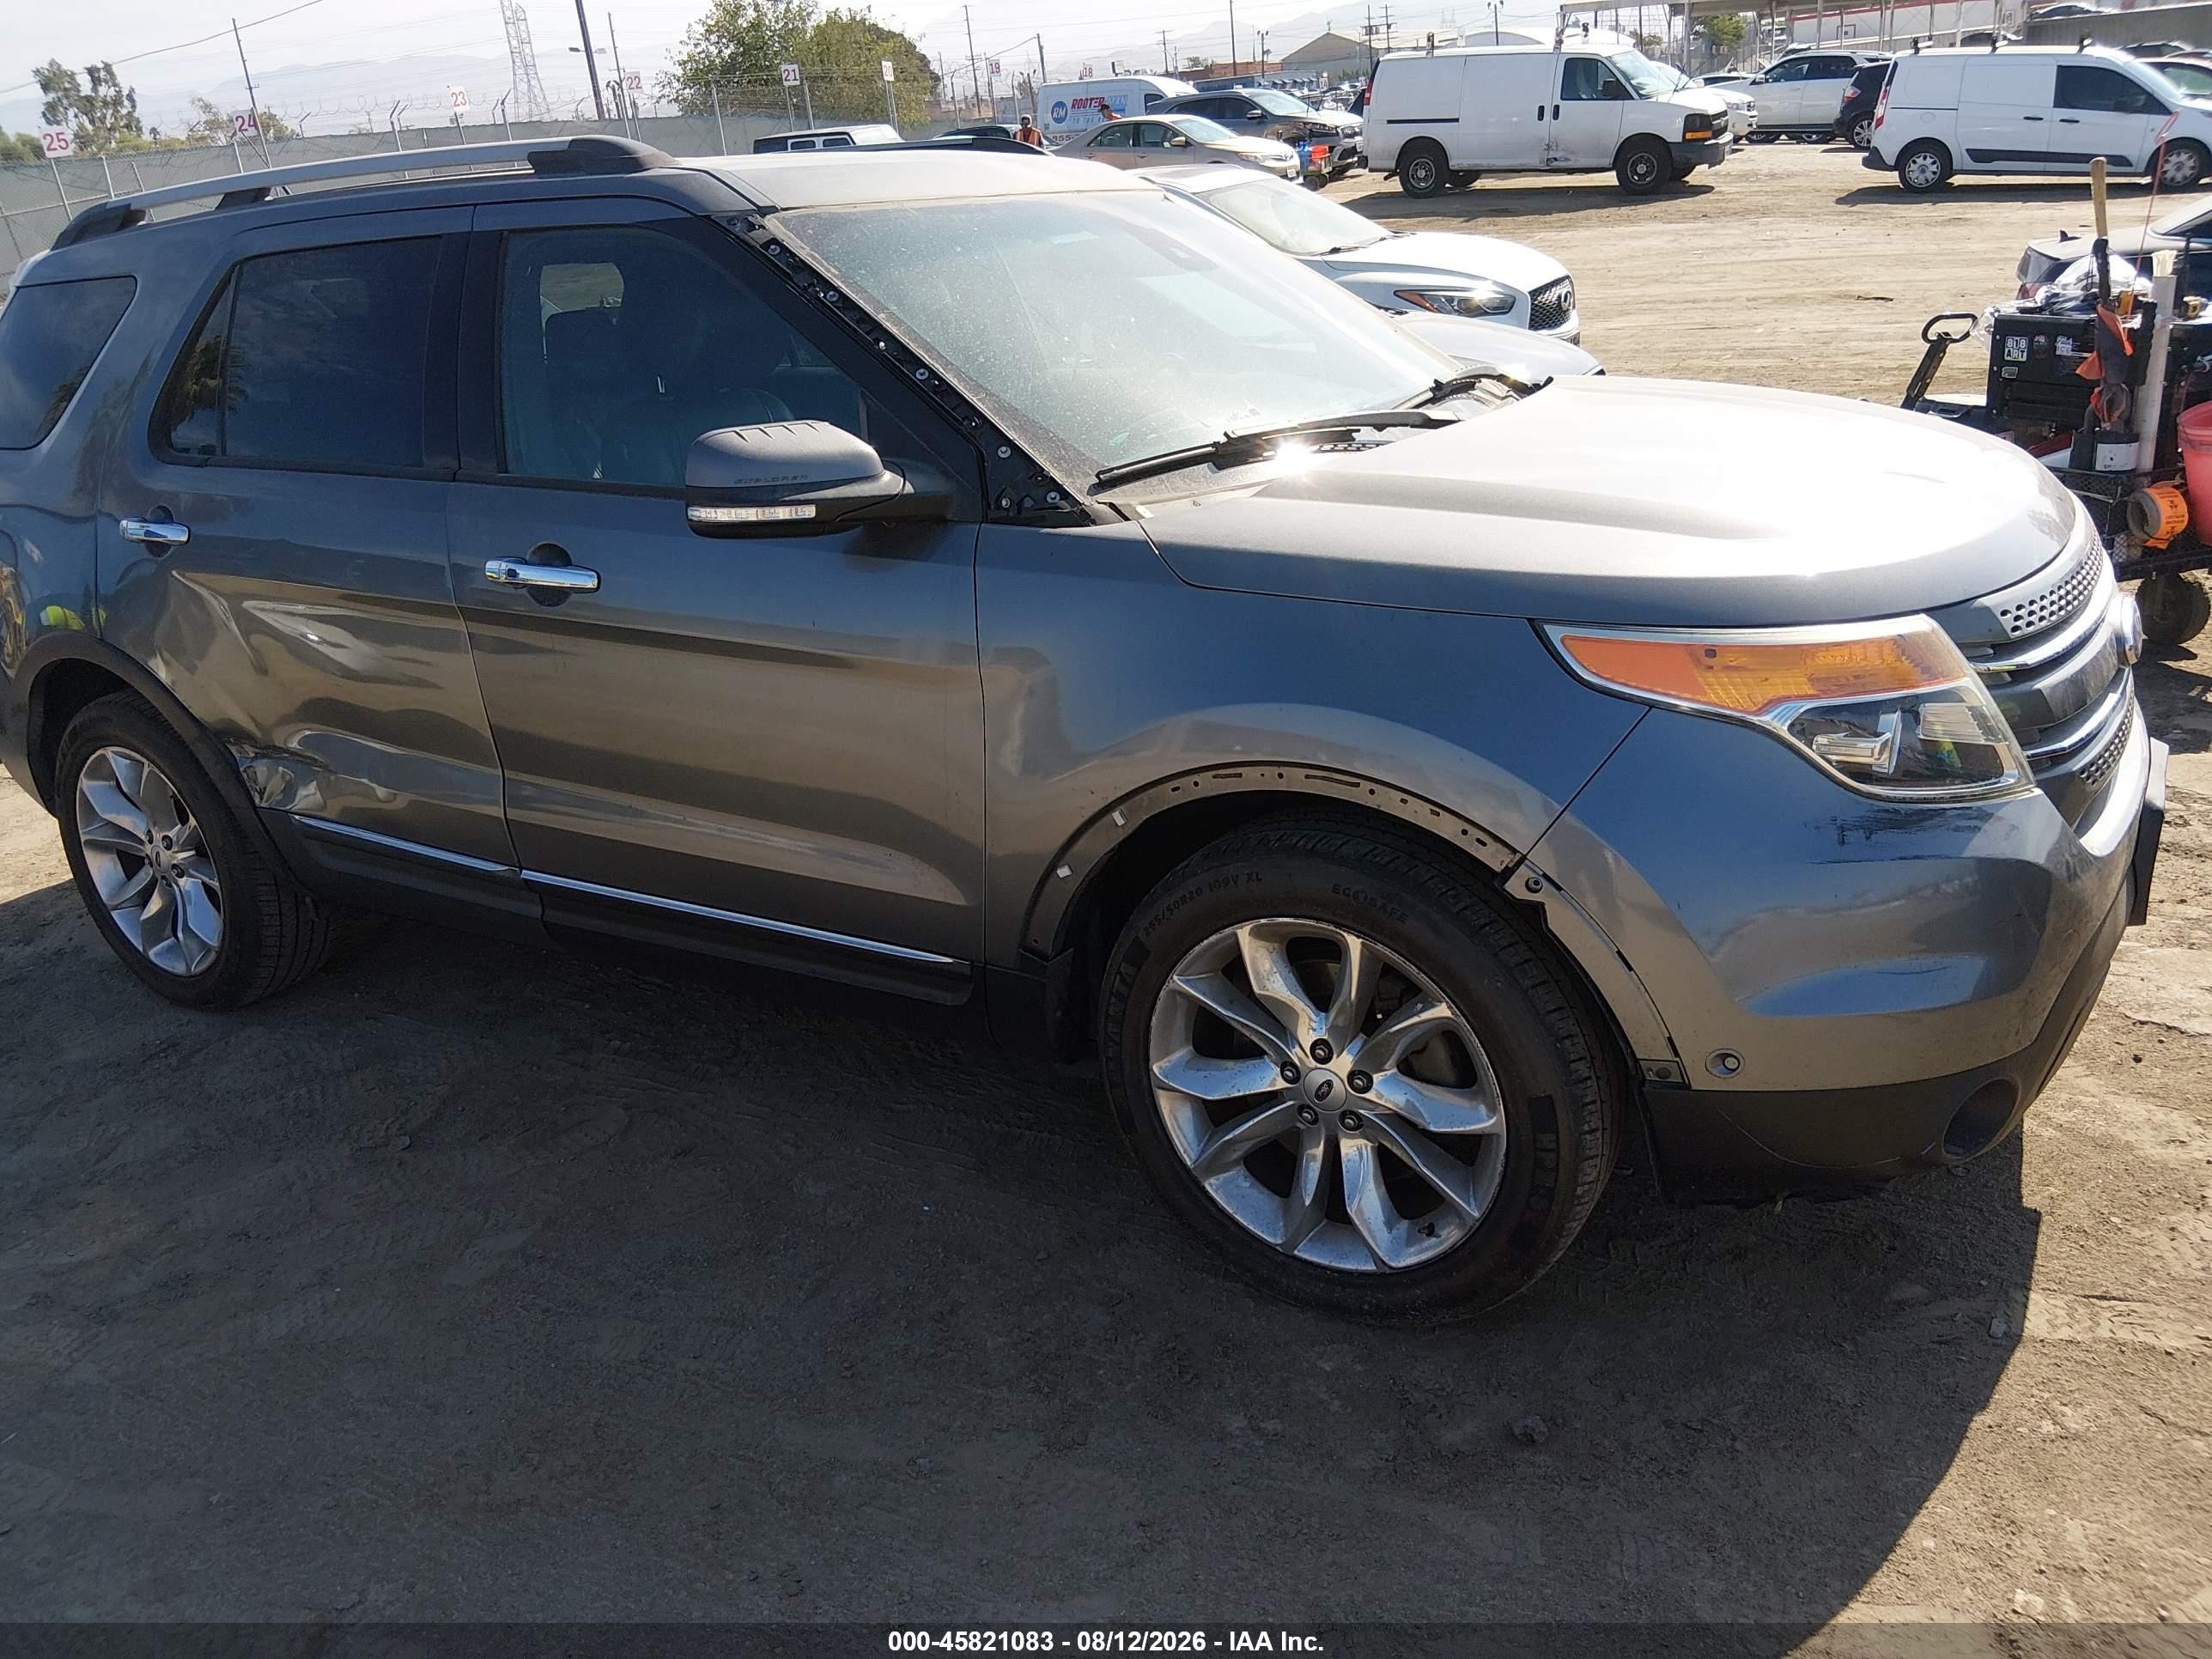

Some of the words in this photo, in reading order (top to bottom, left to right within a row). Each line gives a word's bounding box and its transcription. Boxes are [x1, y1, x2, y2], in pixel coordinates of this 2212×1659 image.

[883, 64, 893, 77] 20
[989, 63, 1000, 74] 19
[1085, 68, 1093, 77] 18
[783, 69, 799, 82] 21
[626, 76, 642, 90] 22
[451, 91, 467, 107] 23
[1053, 107, 1066, 118] RM
[234, 114, 258, 132] 24
[43, 131, 70, 152] 25
[2007, 338, 2027, 349] 818
[2006, 349, 2026, 359] ART
[1244, 871, 1264, 884] XL
